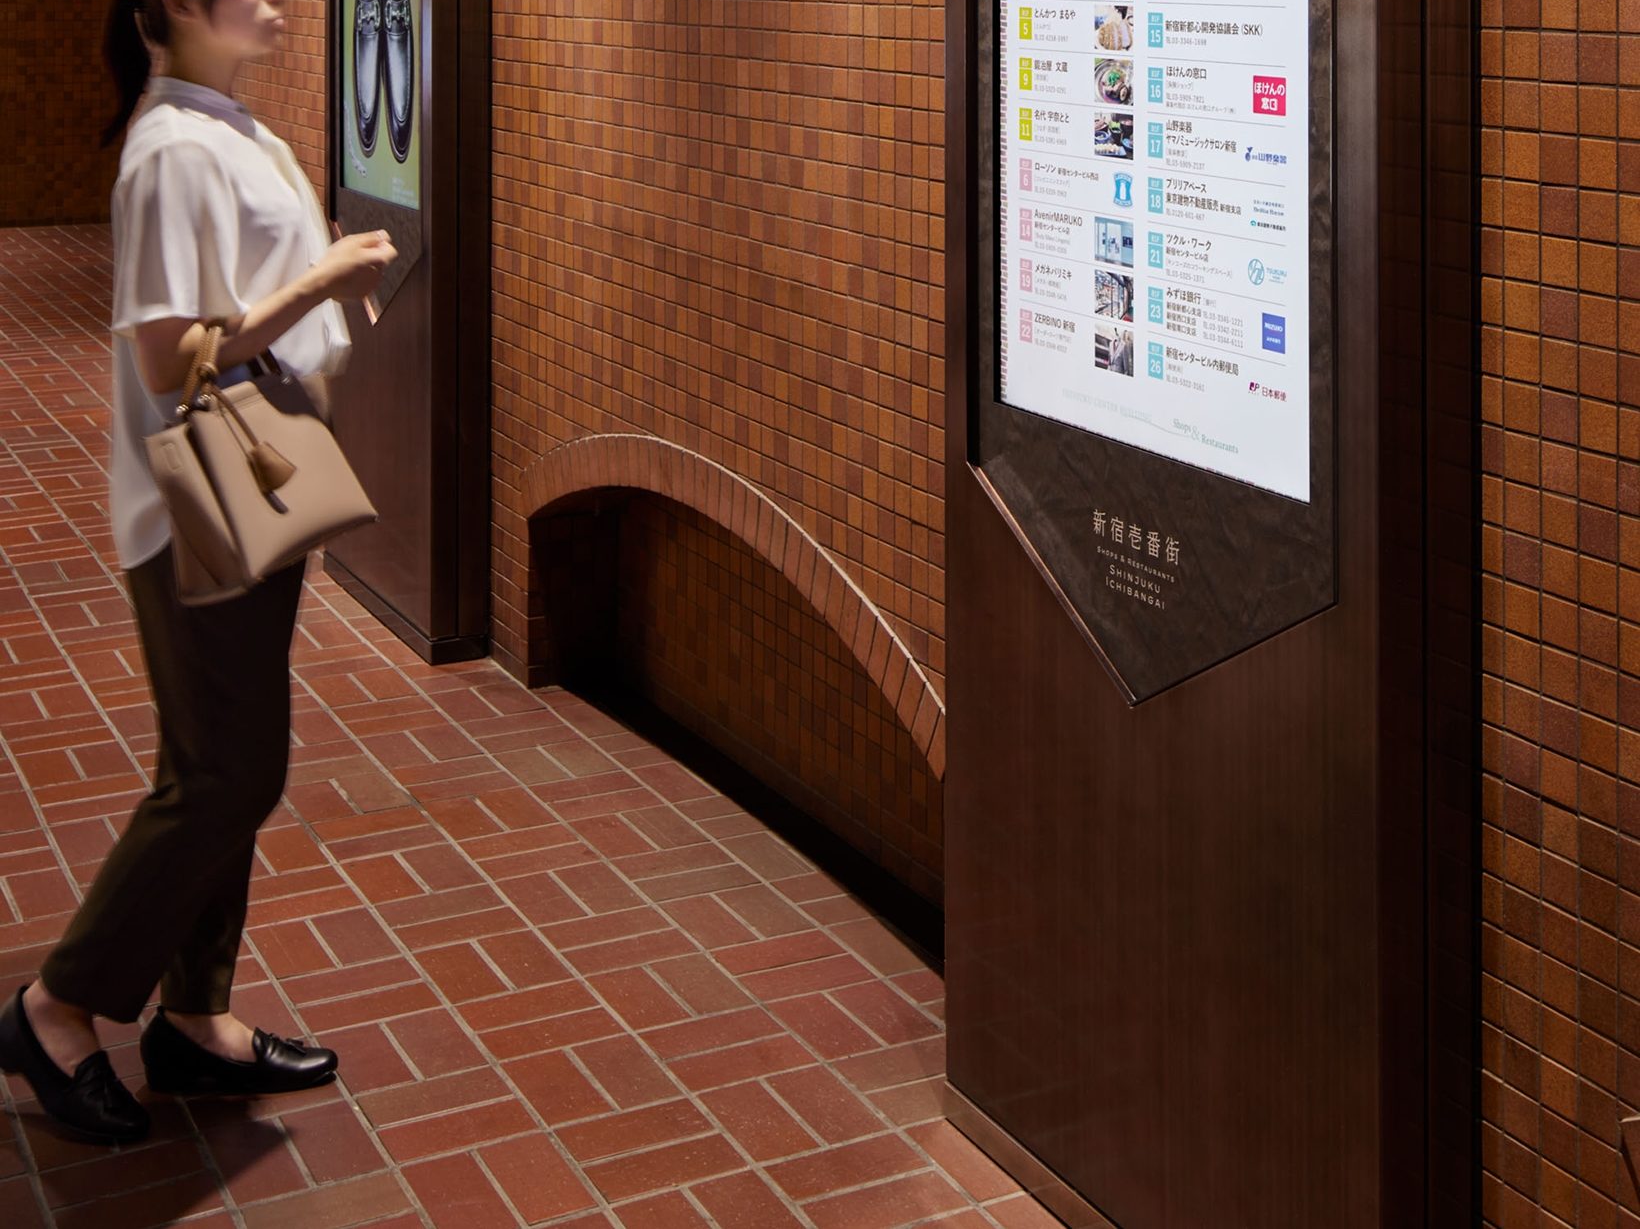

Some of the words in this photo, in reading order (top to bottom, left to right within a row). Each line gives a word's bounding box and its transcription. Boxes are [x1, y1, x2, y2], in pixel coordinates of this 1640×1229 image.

[1034, 8, 1056, 18] とんかつ
[1060, 9, 1075, 19] まるや
[1166, 20, 1239, 35] 新宿新都心開発協議会
[1150, 30, 1160, 43] 15
[1166, 66, 1207, 79] ほけんの窓口
[1150, 85, 1160, 98] 16
[1254, 82, 1285, 96] ほけんの
[1261, 98, 1278, 110] 窓口
[1150, 140, 1160, 153] 17
[1034, 162, 1056, 173] ローソン
[1150, 195, 1160, 209] 18
[1150, 249, 1160, 263] 21
[1167, 287, 1201, 305] みずほ銀行
[1150, 304, 1160, 318] 23
[1034, 312, 1061, 329] ZERBINO
[1150, 359, 1160, 373] 26
[1201, 435, 1238, 454] Restaurants
[1093, 509, 1179, 566] 新宿壱番街
[1109, 564, 1160, 593] SHINJUKU
[1106, 576, 1165, 610] ICHIBANGAI
